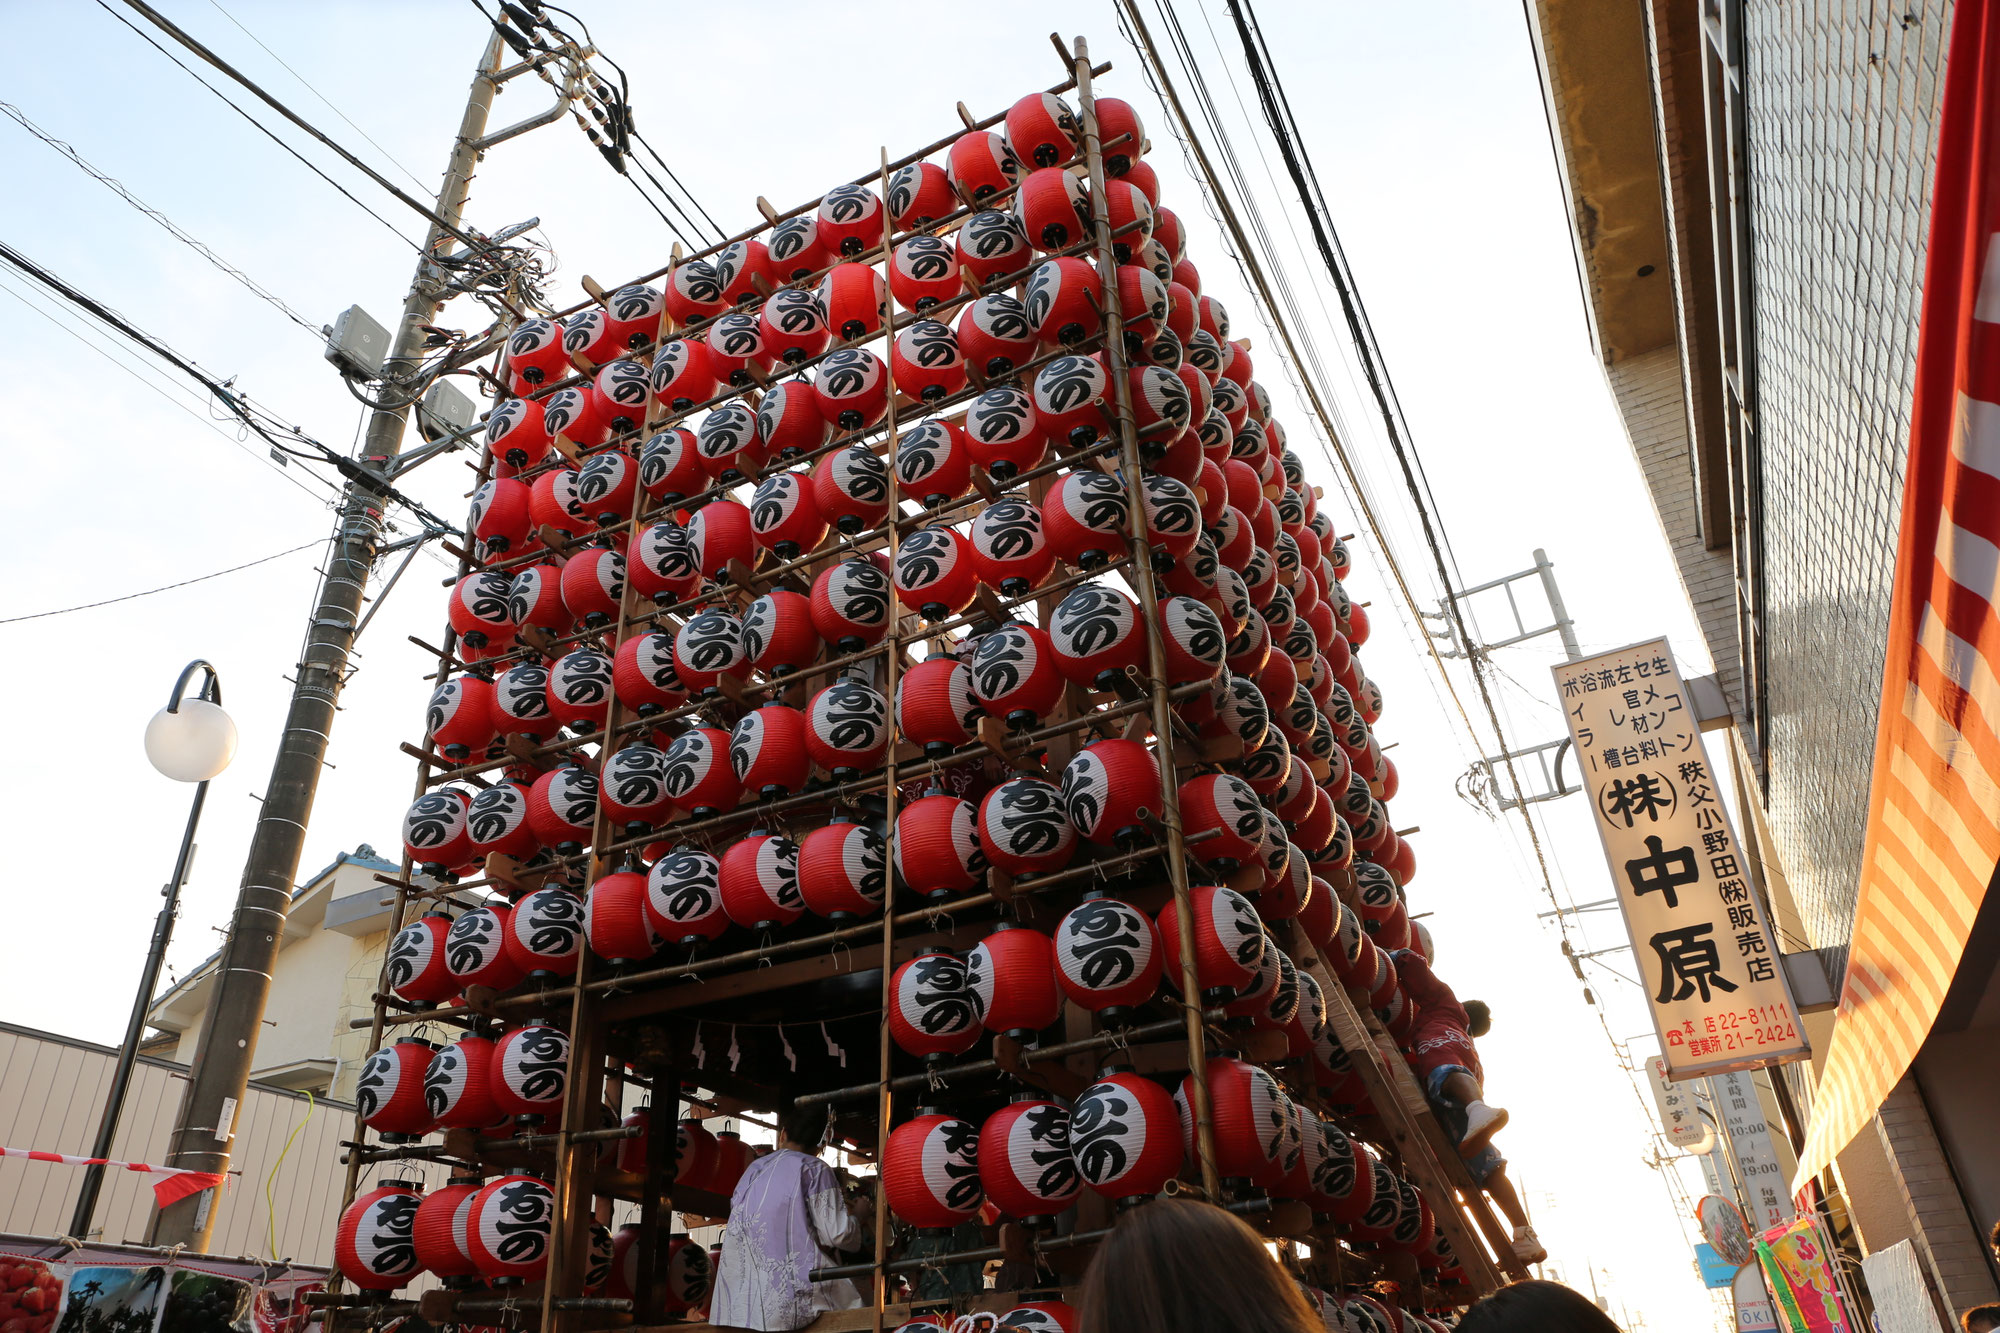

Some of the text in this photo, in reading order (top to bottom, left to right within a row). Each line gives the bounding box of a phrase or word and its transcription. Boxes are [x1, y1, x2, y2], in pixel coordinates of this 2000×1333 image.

[1597, 669, 1640, 765] 流し台
[1615, 665, 1658, 760] 左官材料
[1633, 661, 1675, 756] セメント
[1652, 656, 1693, 752] 生コン
[1563, 677, 1598, 772] ボイラー
[1718, 1002, 1788, 1030] 22-8111
[1688, 1022, 1796, 1057] 営業所 21-2424
[1662, 1081, 1684, 1123] しみず
[1729, 1117, 1743, 1125] AM
[1730, 1122, 1766, 1137] 10:00
[1740, 1156, 1755, 1166] PM
[1742, 1162, 1778, 1177] 19:00
[1736, 1300, 1769, 1309] COSMETIC
